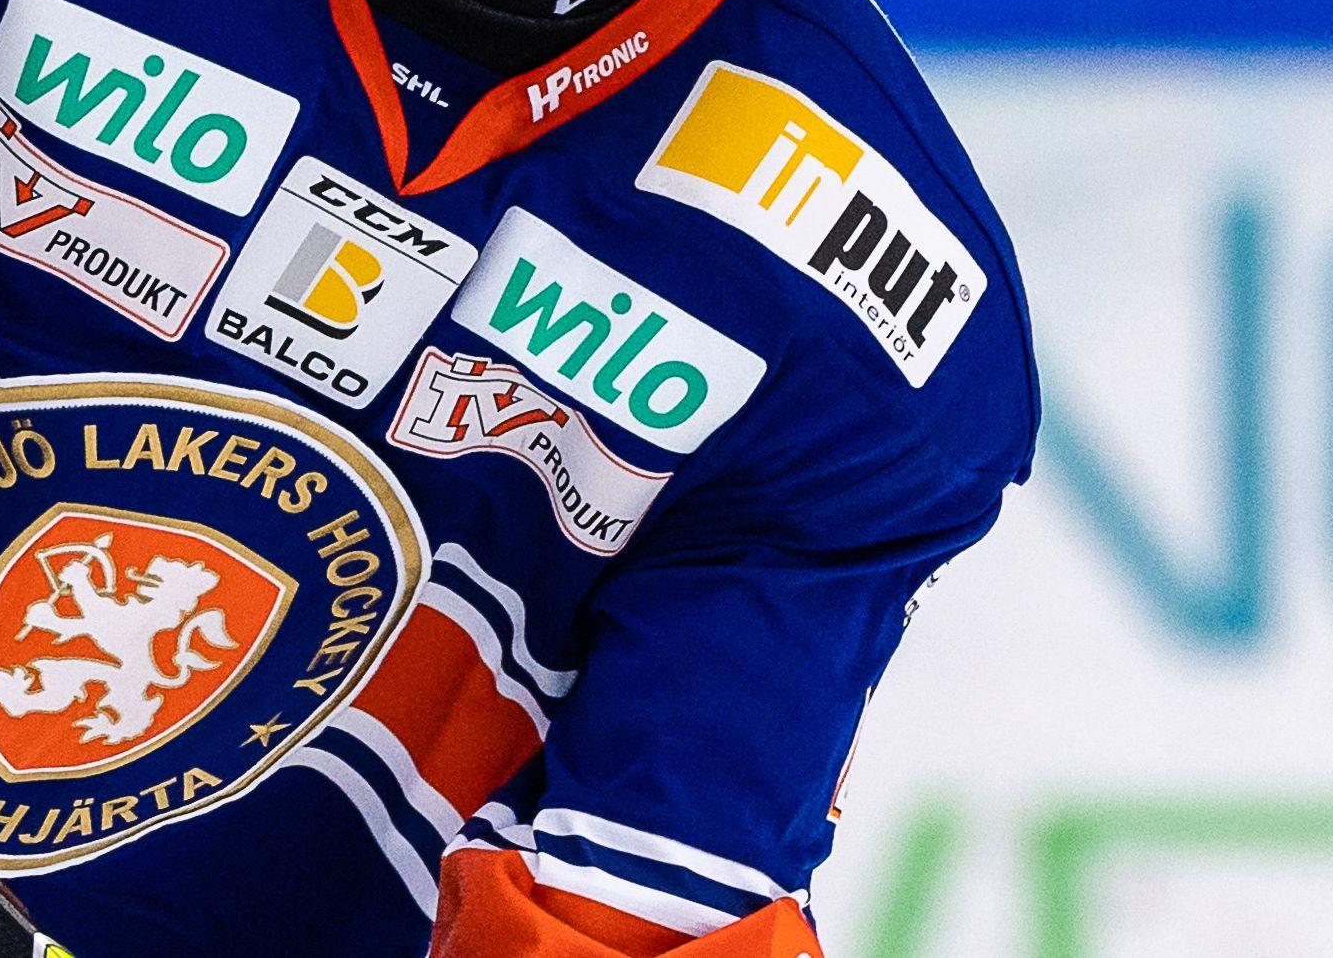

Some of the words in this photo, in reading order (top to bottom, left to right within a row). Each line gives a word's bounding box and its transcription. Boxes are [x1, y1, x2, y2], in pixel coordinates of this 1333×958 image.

[14, 33, 248, 183] wilo
[392, 62, 449, 108] SHL
[309, 174, 450, 258] CCM
[45, 230, 187, 319] PRODUKT
[835, 270, 916, 364] interiör
[216, 308, 369, 397] BALCO
[490, 256, 709, 430] wilo
[529, 433, 634, 544] PRODUKT
[84, 423, 327, 514] LAKERS
[293, 509, 380, 696] HOCKEY
